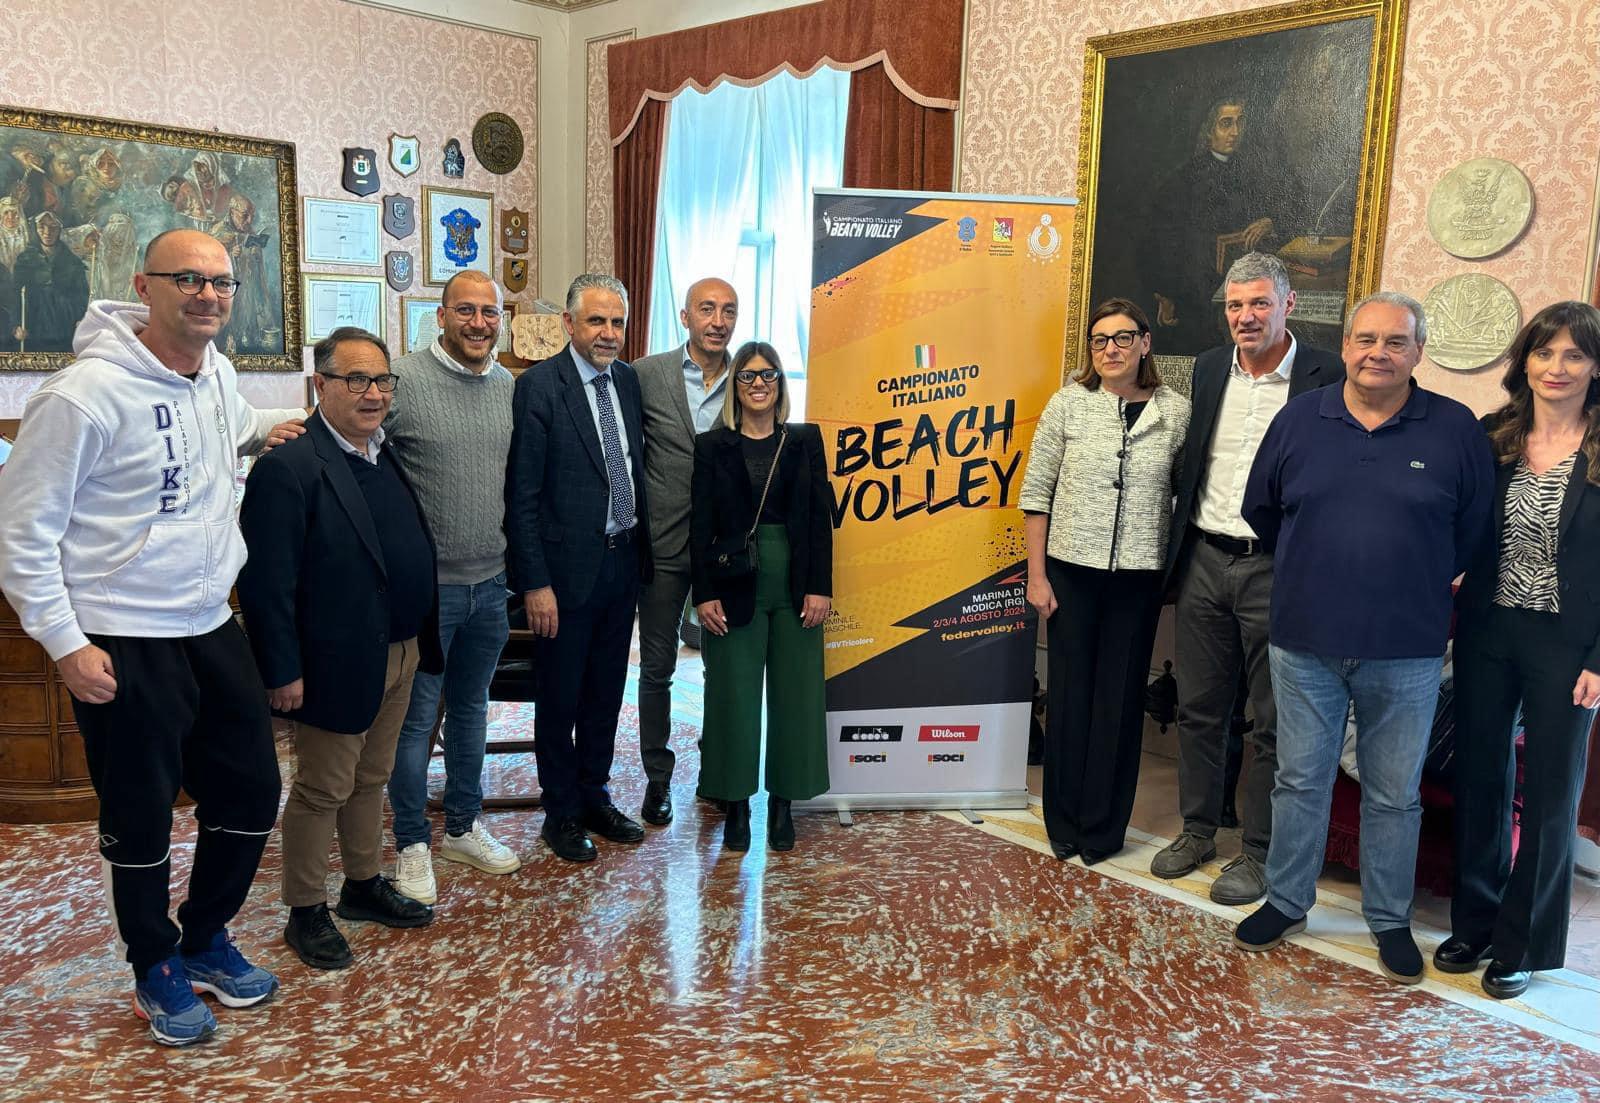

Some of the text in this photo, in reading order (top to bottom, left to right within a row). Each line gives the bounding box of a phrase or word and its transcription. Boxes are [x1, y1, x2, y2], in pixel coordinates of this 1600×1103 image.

[830, 222, 902, 239] BEACH VOLLEY
[833, 216, 903, 225] CAMPIONATO ITALIANO
[877, 364, 979, 393] CAMPIONATO
[892, 383, 967, 408] ITALIANO
[833, 399, 1016, 477] BEACH
[152, 403, 182, 515] DIKE
[828, 450, 1024, 529] VOLLEY
[962, 597, 1025, 614] MODICA (RG)
[972, 587, 1024, 603] MARINA DI
[933, 606, 1026, 628] 2/3/4 AGOSTO 2024
[941, 621, 1025, 642] federvolley.it
[931, 728, 966, 739] Wilson
